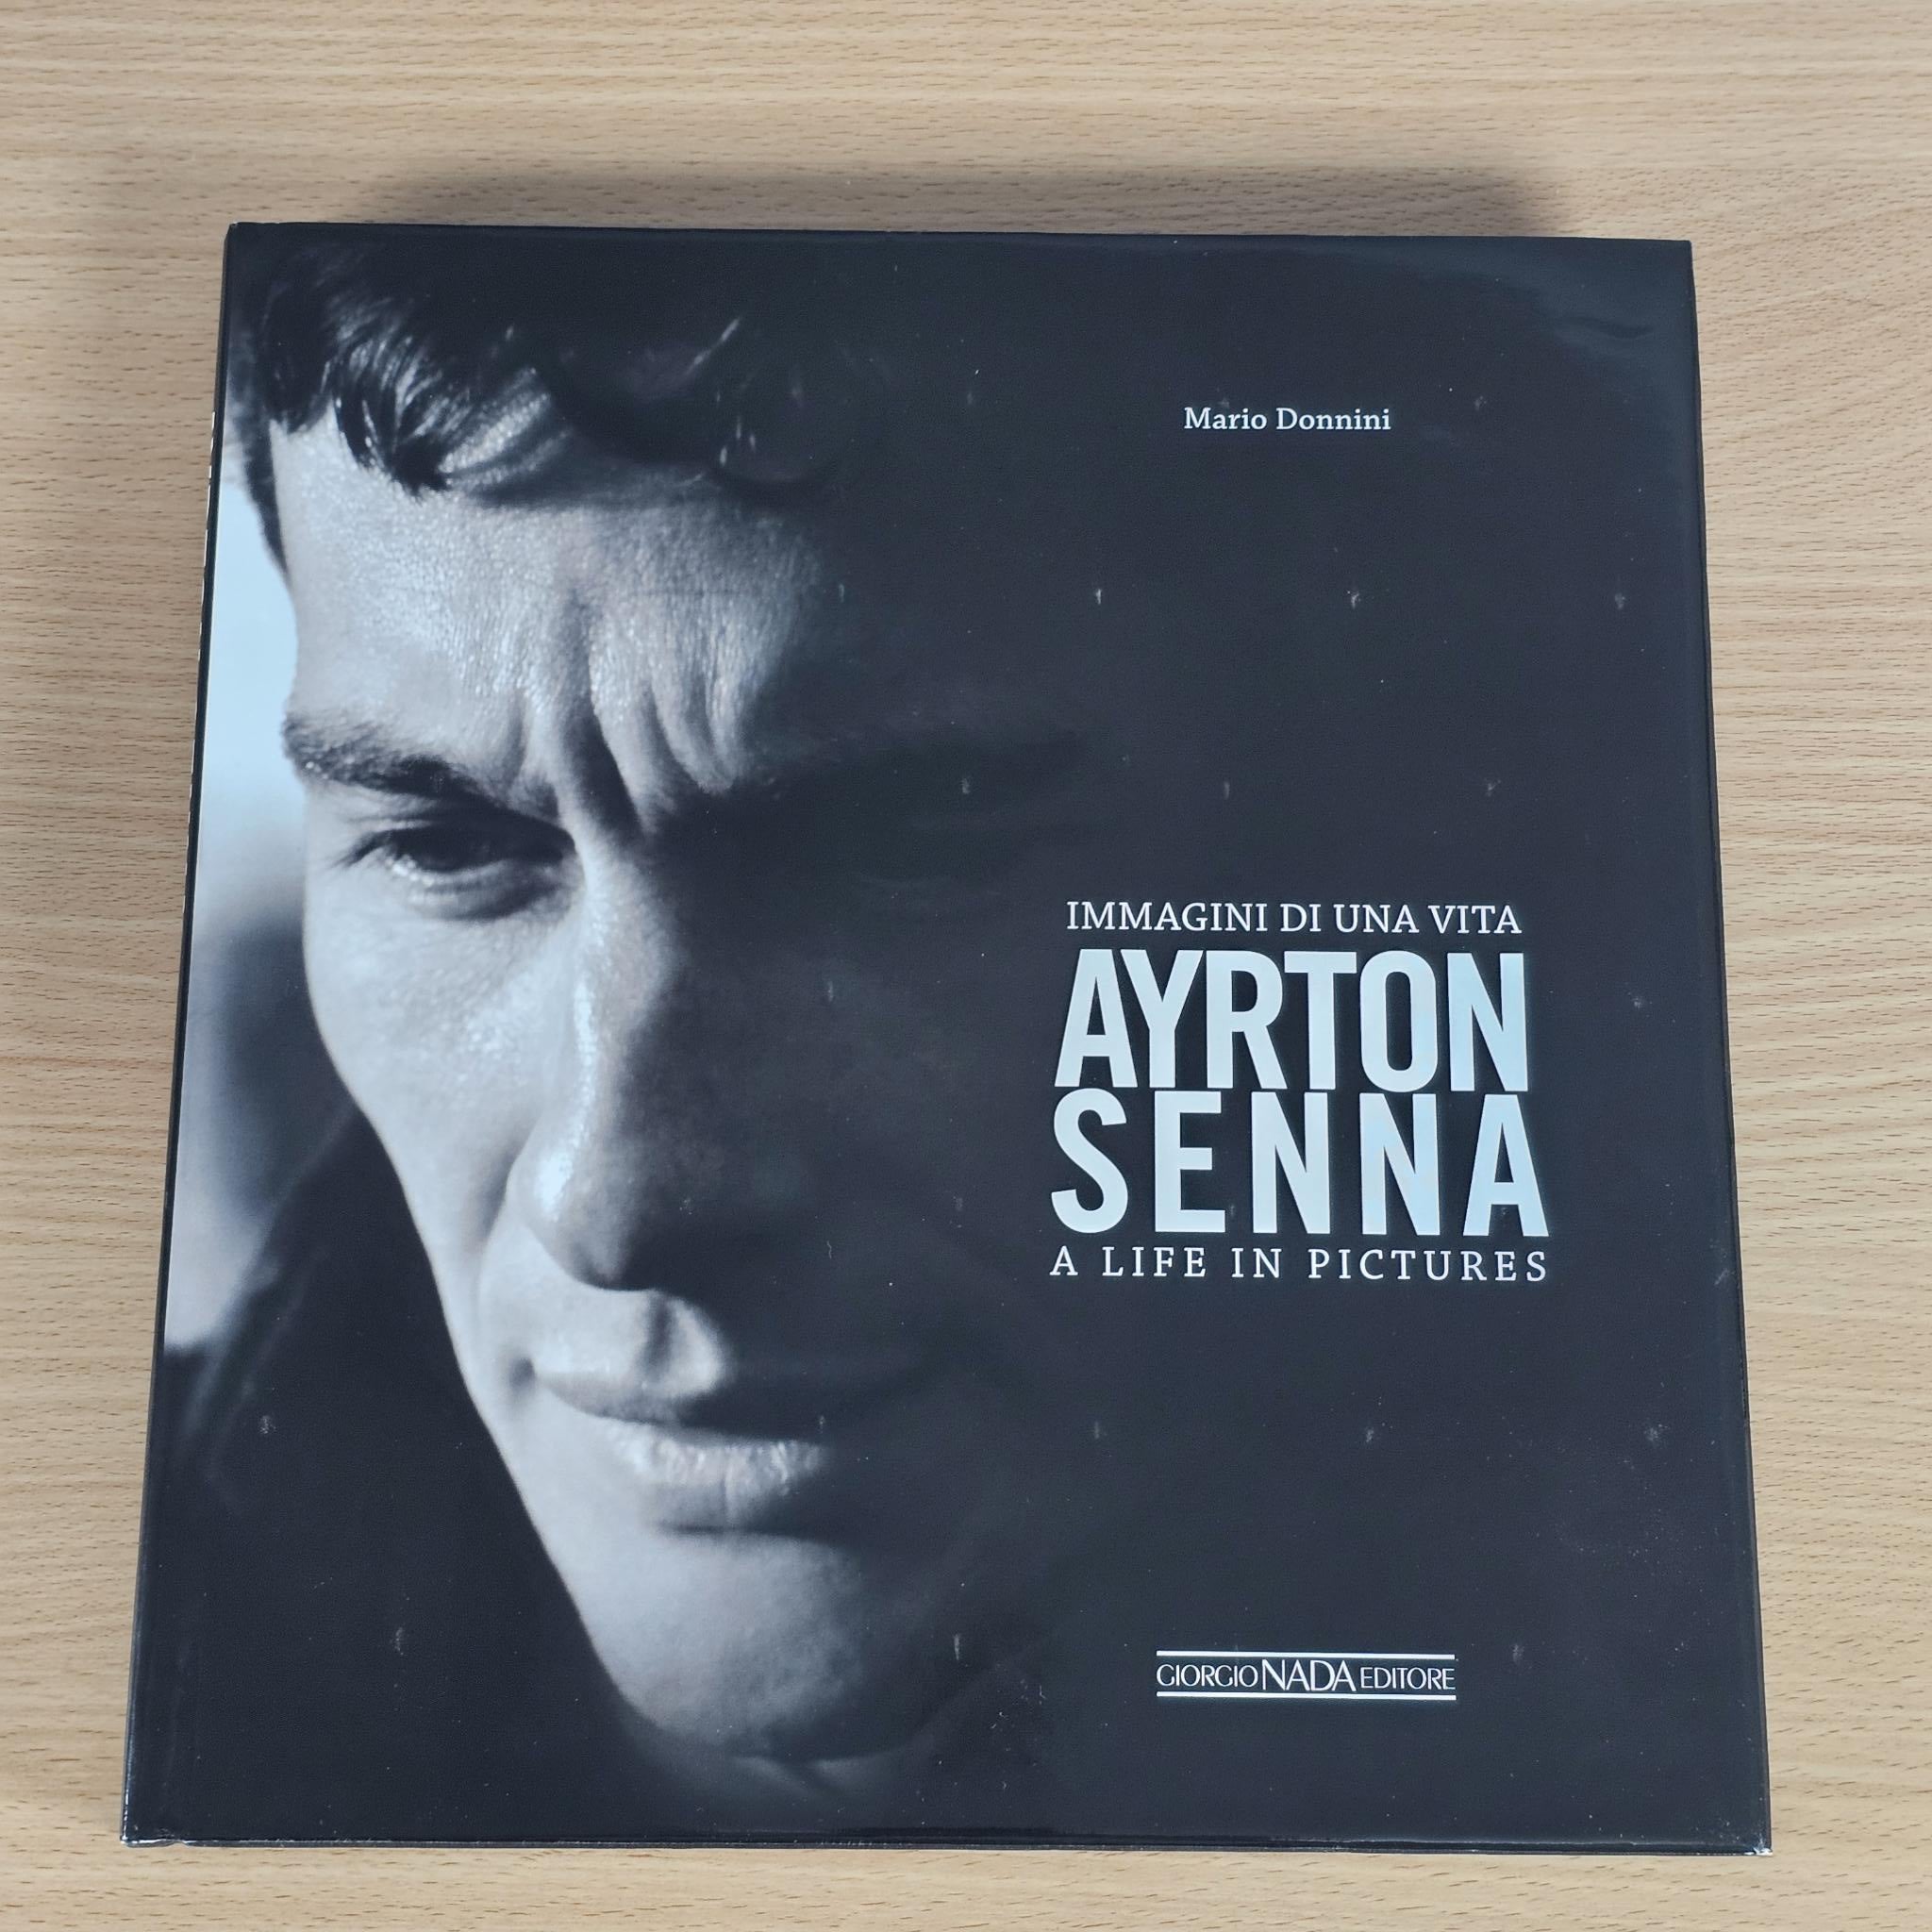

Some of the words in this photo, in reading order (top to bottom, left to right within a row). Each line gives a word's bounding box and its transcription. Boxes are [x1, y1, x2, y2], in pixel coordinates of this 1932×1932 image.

[1183, 406, 1268, 430] Mario
[1275, 407, 1391, 431] Donnini
[1066, 901, 1268, 932] IMMAGINI
[1279, 903, 1322, 932] DI
[1333, 904, 1420, 934] UNA
[1427, 905, 1523, 934] VITA
[1054, 948, 1529, 1092] AYRTON
[1051, 1088, 1550, 1238] SENNA
[1049, 1245, 1079, 1276] A
[1102, 1246, 1207, 1277] LIFE
[1231, 1247, 1282, 1278] IN
[1307, 1248, 1546, 1282] PICTURES
[1156, 1663, 1258, 1688] GIORGIO
[1261, 1658, 1357, 1692] NADA
[1359, 1666, 1457, 1690] EDITORE
